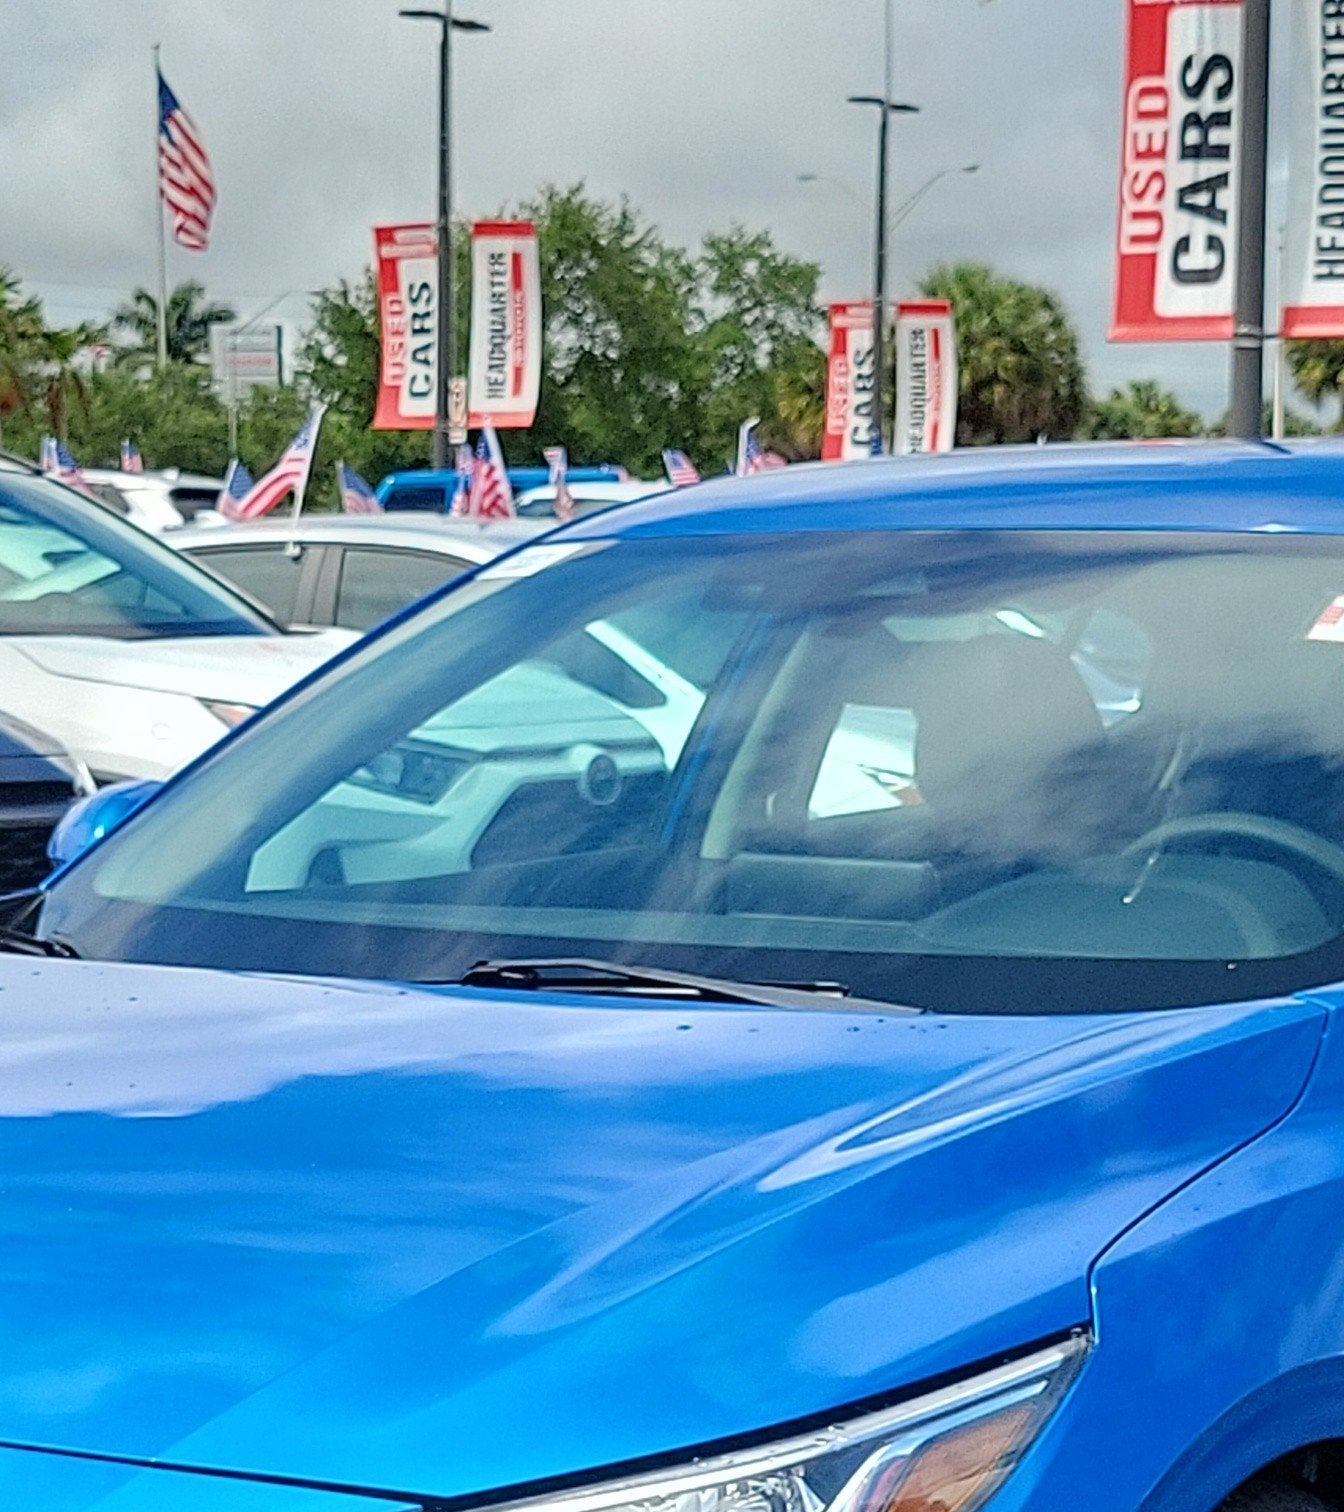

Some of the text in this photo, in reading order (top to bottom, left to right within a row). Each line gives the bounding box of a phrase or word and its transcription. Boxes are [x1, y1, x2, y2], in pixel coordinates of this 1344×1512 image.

[1129, 84, 1169, 245] USED
[1172, 52, 1234, 285] CARS
[389, 299, 404, 381] USED
[408, 281, 433, 399] CARS
[486, 251, 509, 399] HEADQUARTER
